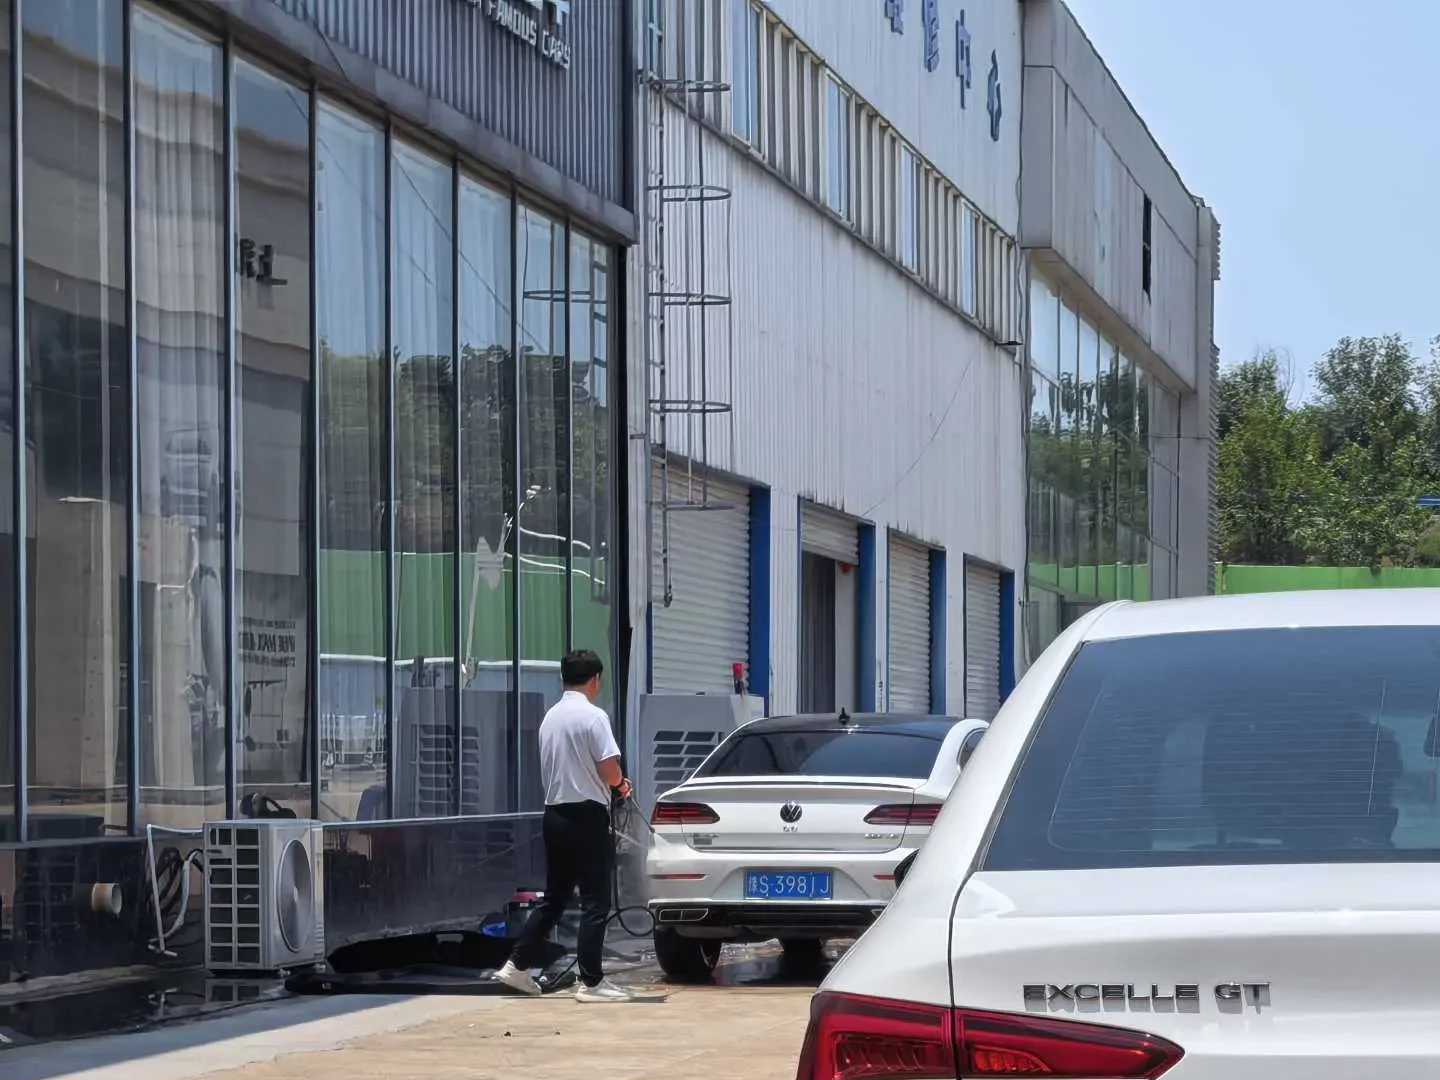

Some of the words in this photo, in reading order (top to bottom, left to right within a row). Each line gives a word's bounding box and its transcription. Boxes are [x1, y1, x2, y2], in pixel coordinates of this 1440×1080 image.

[542, 29, 571, 69] CARS
[1022, 983, 1200, 1001] EXCELLE
[1213, 982, 1271, 1001] GT
